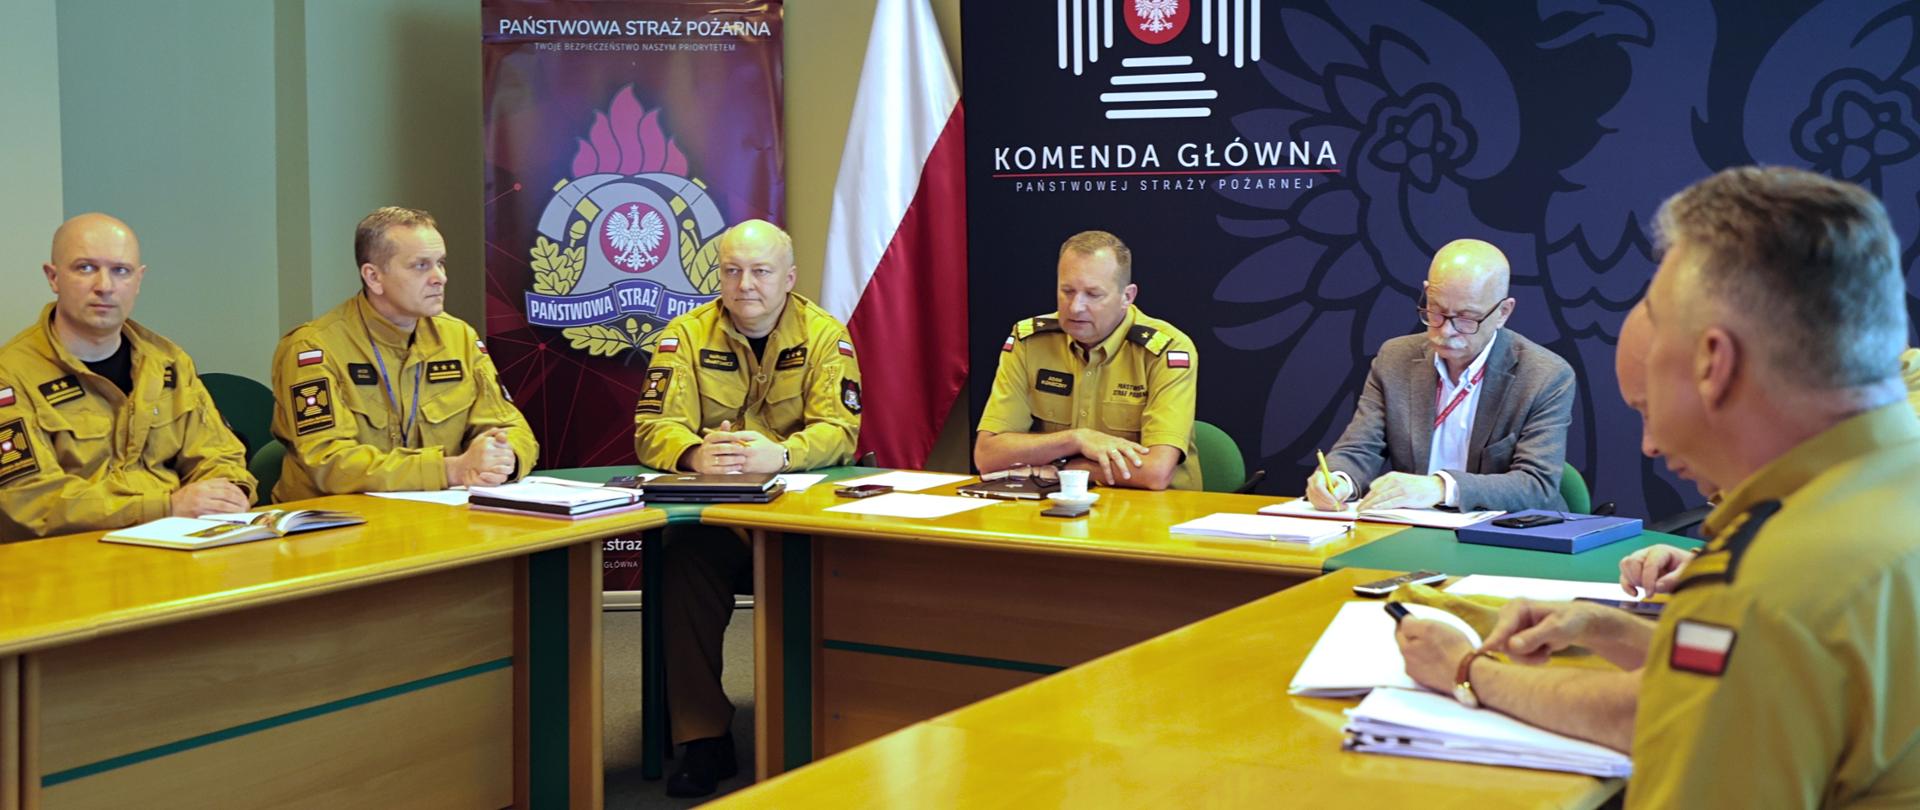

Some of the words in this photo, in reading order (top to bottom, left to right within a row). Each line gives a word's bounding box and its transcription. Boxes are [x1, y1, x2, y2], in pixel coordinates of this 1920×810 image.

[500, 16, 621, 36] PAŃSTWOWA
[625, 17, 682, 36] STRAŻ
[687, 18, 771, 37] POŻARNA
[535, 42, 561, 52] TWOJE
[564, 41, 640, 51] BEZPIECZEŃSTWO
[642, 43, 677, 51] NASZYM
[678, 43, 736, 52] PRIORYTETEM
[994, 144, 1161, 170] KOMENDA
[1177, 137, 1337, 168] GŁÓWNA
[1016, 179, 1129, 193] PAŃSTWOWEJ
[1140, 178, 1208, 192] STRAŻY
[1219, 177, 1314, 191] POŻARNEJ
[531, 295, 614, 321] PAŃSTWOWA
[618, 287, 659, 309] STRAŻ
[667, 297, 702, 317] POŻ
[604, 560, 638, 568] GŁÓWNA
